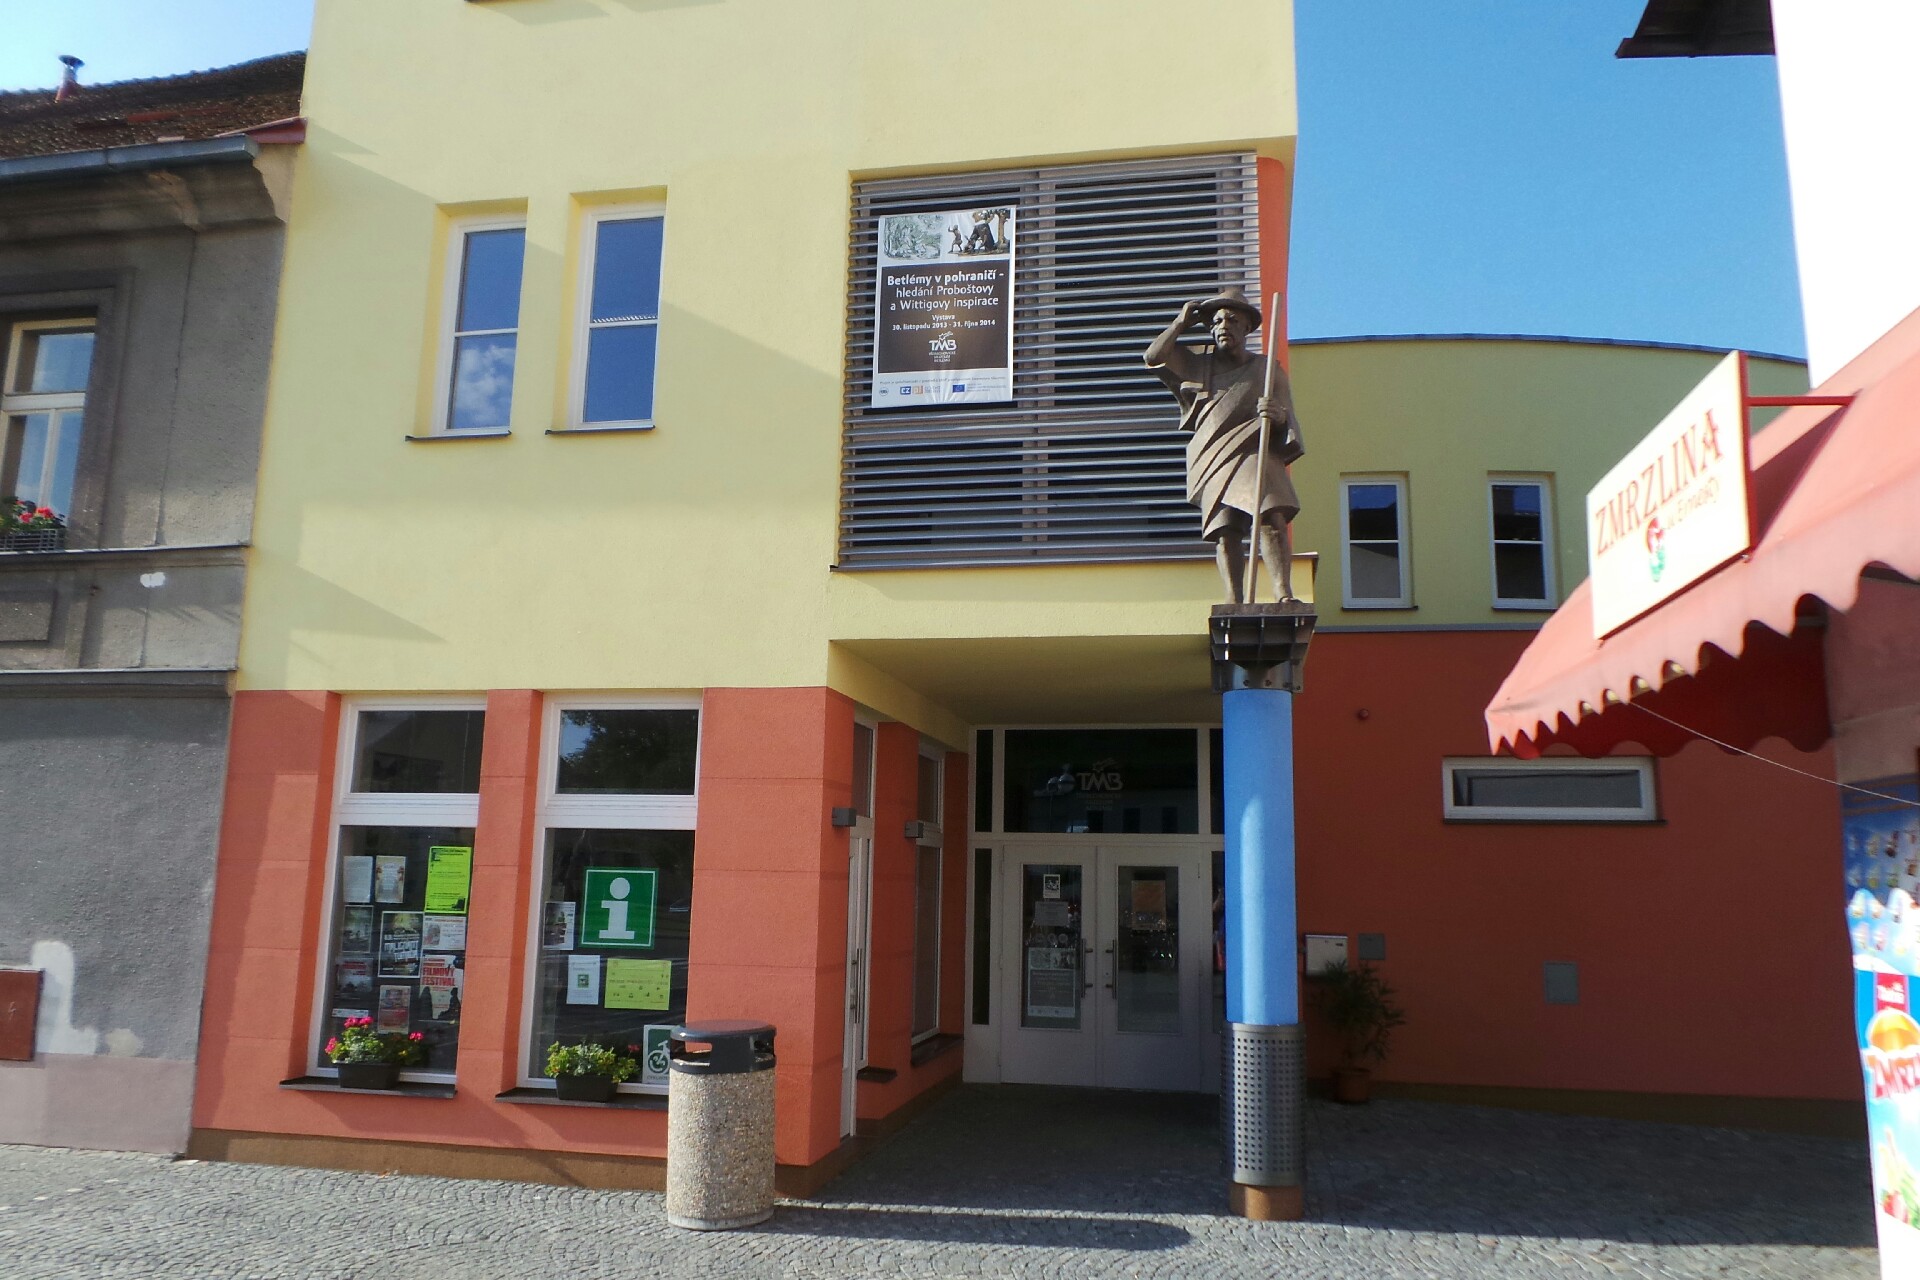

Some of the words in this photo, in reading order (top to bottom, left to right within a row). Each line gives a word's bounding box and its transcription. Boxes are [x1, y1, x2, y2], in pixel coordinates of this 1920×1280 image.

[887, 274, 932, 286] Betlémy
[935, 275, 942, 283] v
[944, 269, 997, 285] pohraničí
[896, 286, 933, 298] hledání
[936, 284, 994, 296] Proboštovy
[890, 303, 896, 311] a
[900, 299, 950, 311] Wittigovy
[953, 297, 999, 309] inspirace
[903, 323, 931, 331] listopadu
[929, 339, 957, 351] TMB
[1595, 407, 1723, 557] ZMRZLINA
[1076, 772, 1124, 791] TMB
